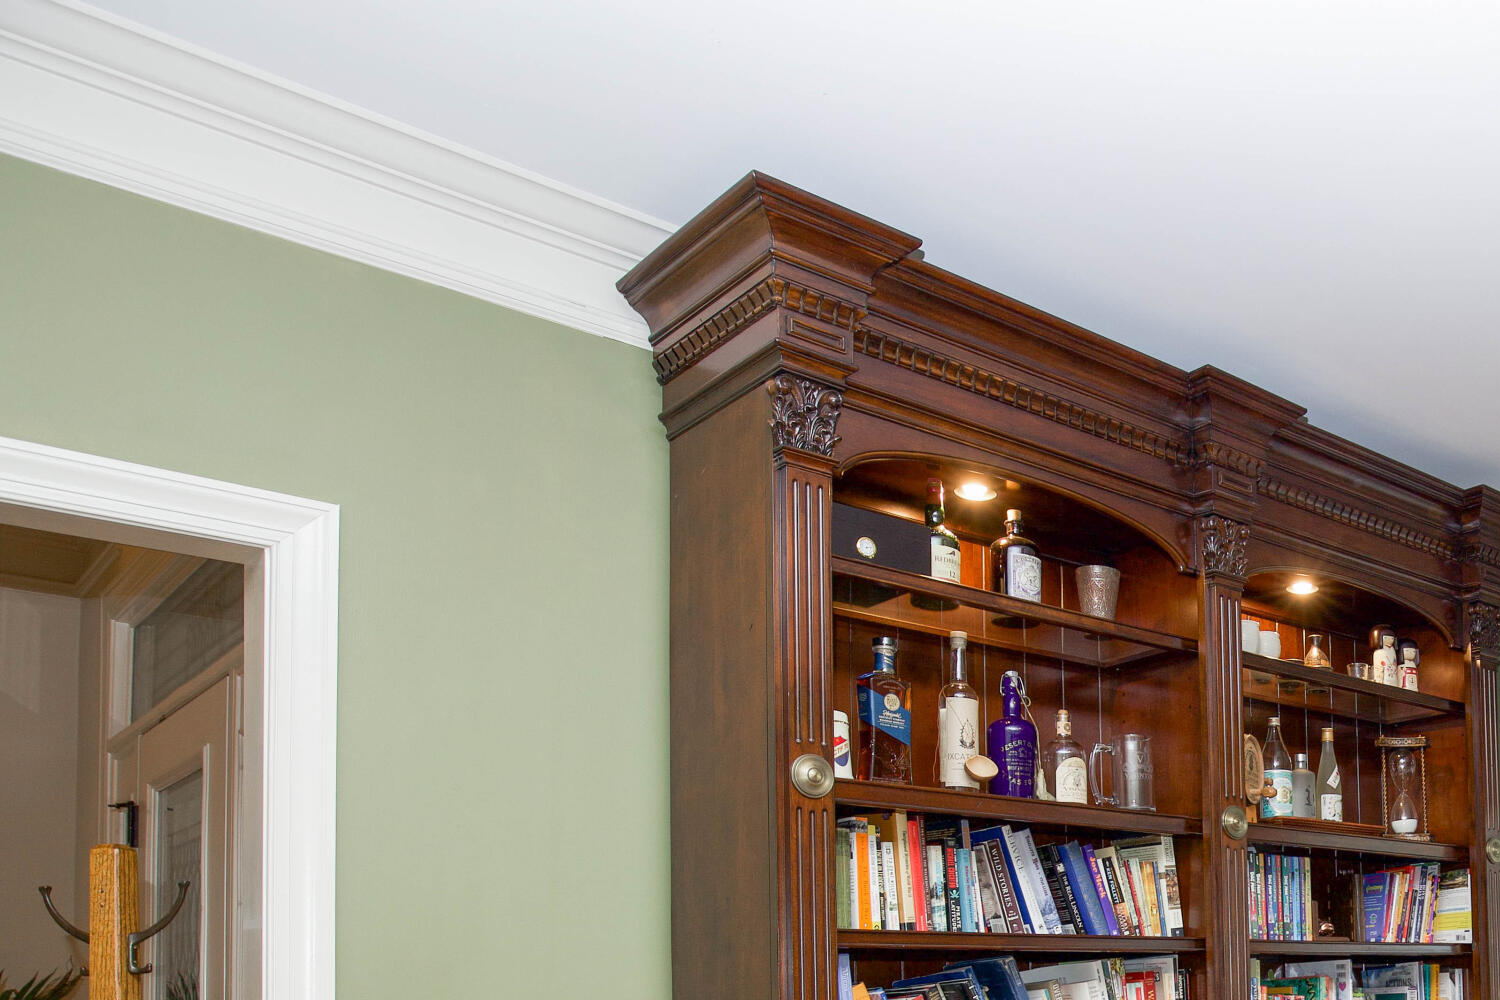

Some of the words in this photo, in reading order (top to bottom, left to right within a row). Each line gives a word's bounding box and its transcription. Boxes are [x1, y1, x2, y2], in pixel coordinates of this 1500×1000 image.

[1005, 829, 1025, 873] SERVICE
[1089, 856, 1098, 873] Joe
[991, 848, 1002, 870] WILD
[998, 873, 1013, 907] STORIES
[1109, 881, 1120, 904] FOLLETT
[1064, 886, 1073, 901] REAL
[1070, 902, 1083, 928] LINCOLN
